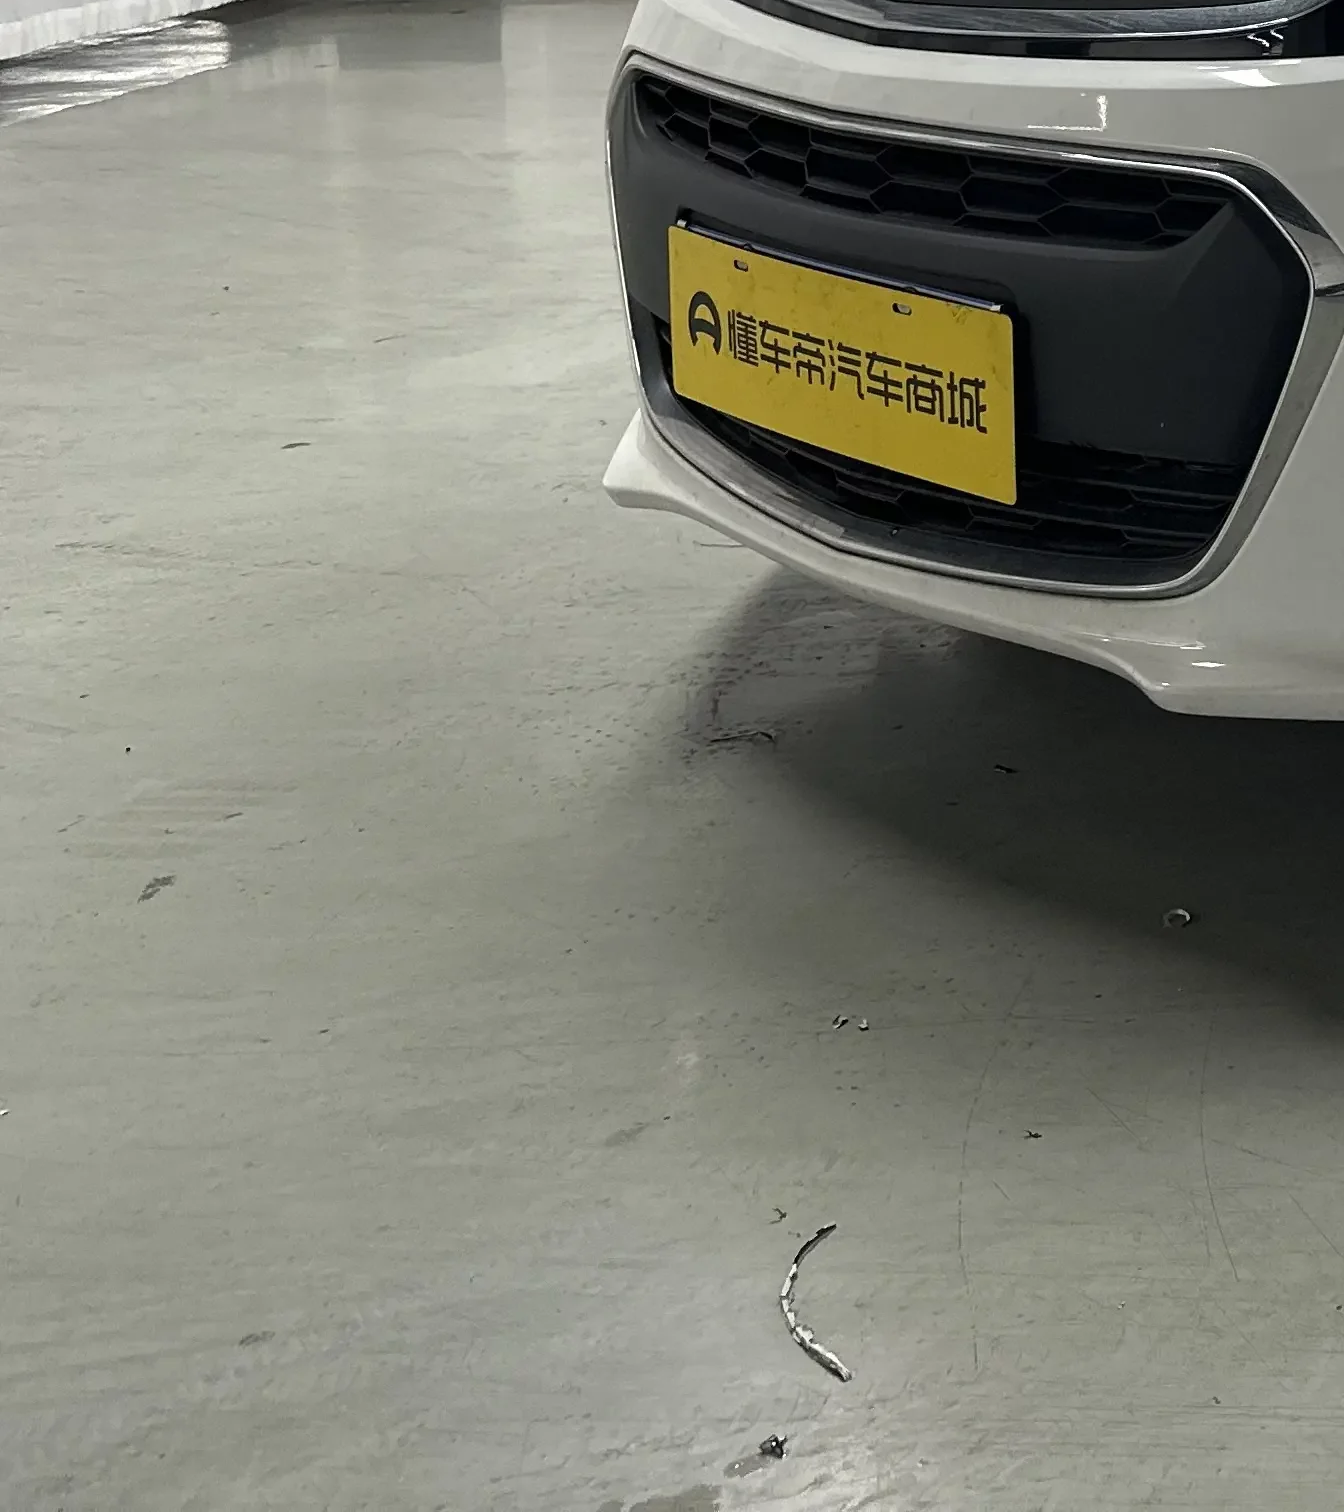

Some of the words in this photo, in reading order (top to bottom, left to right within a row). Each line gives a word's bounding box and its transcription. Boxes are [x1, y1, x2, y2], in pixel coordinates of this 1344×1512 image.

[728, 308, 987, 434] 懂车帝汽车商城
